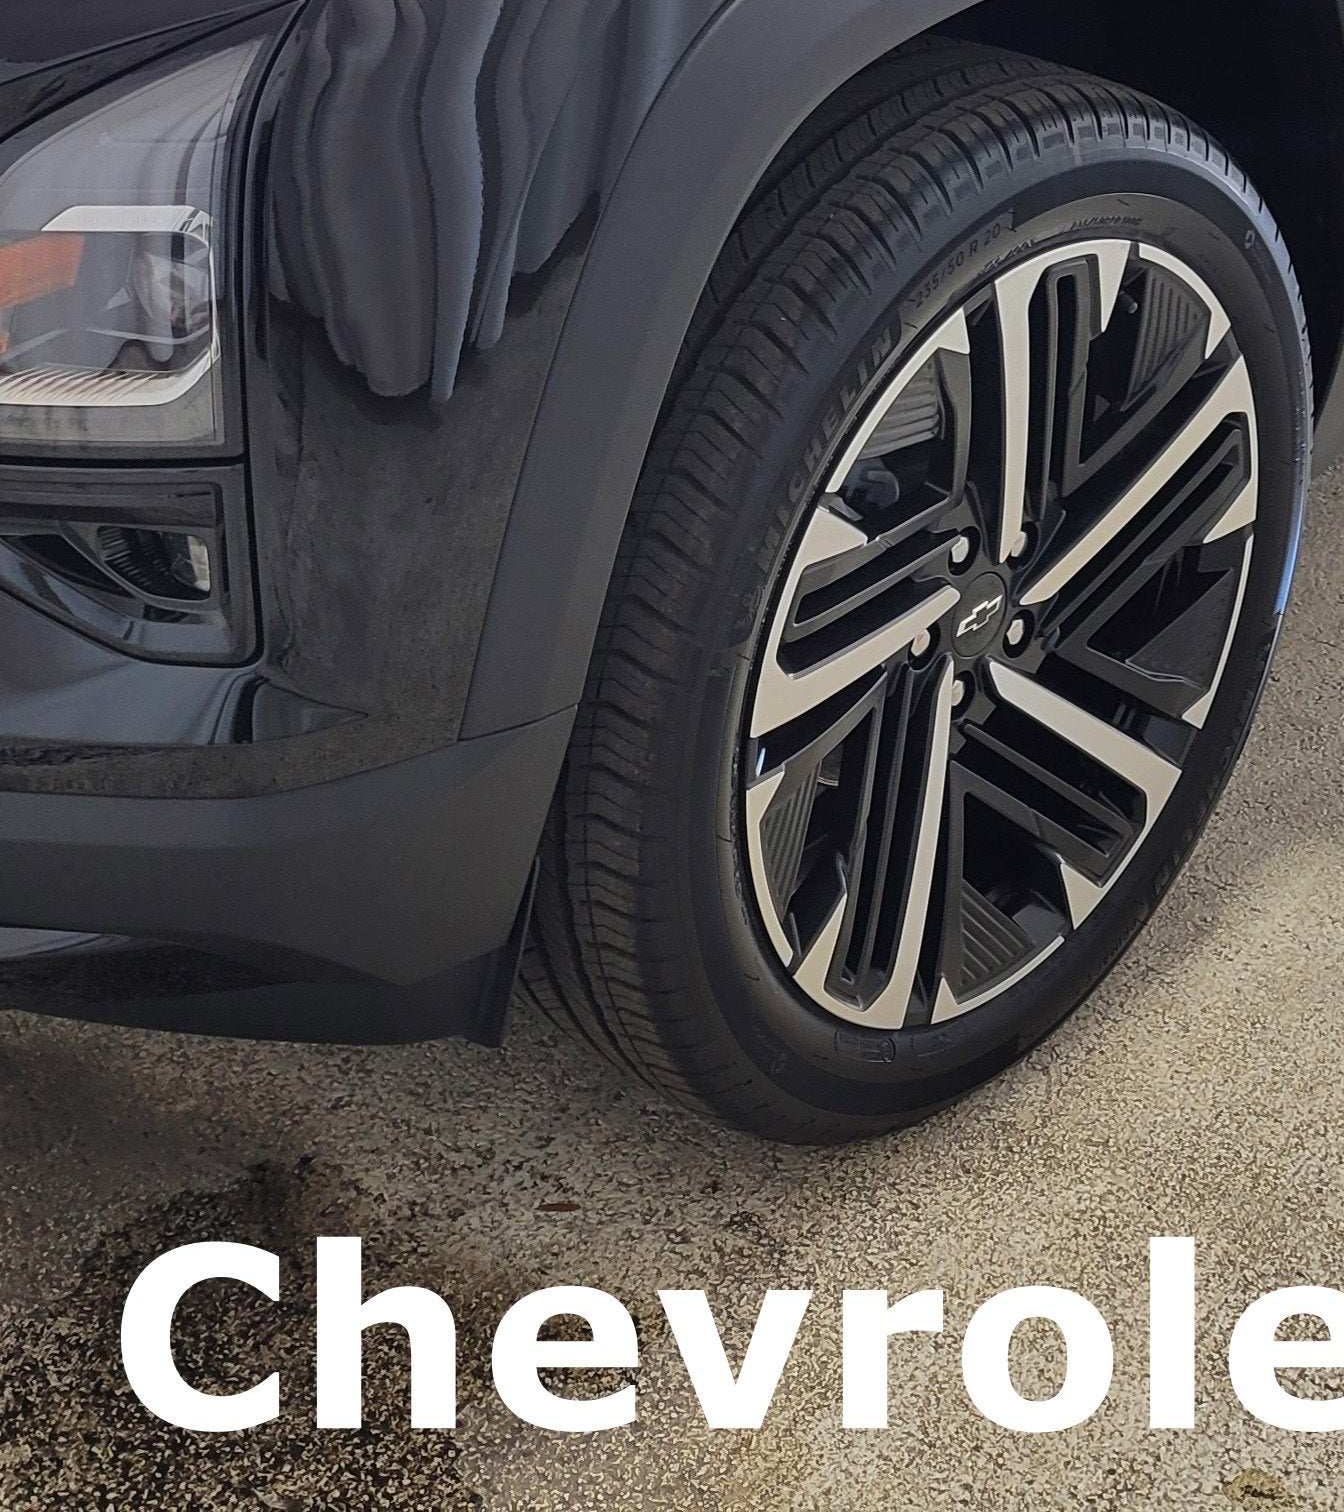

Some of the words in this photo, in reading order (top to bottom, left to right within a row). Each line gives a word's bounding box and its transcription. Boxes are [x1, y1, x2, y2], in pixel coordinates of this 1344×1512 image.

[969, 240, 978, 257] R
[983, 223, 1001, 247] 20
[757, 326, 893, 575] MICHELIN
